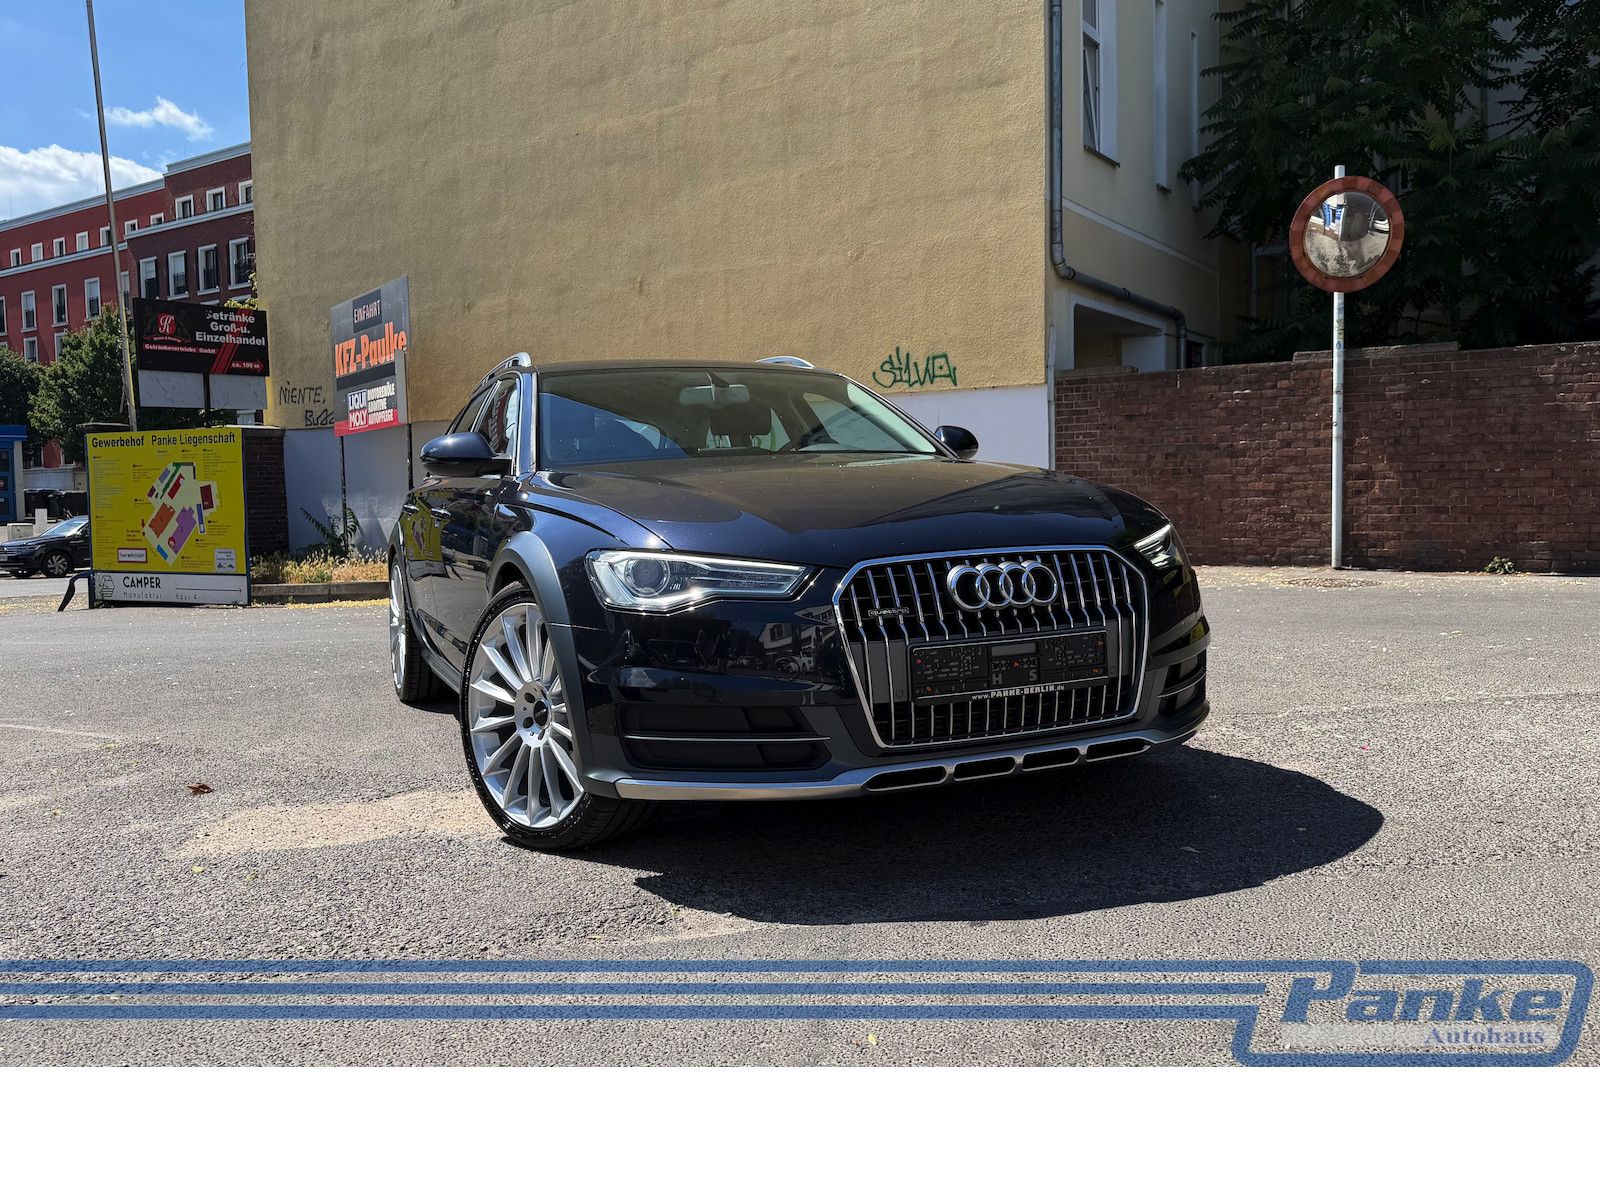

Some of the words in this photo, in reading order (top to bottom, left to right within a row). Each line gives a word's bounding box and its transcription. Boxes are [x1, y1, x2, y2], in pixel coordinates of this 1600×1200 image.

[354, 300, 381, 323] EINFAHRT
[195, 331, 266, 346] Einzelhandel
[335, 321, 407, 378] KFZ-Paulke
[243, 361, 253, 369] 100
[348, 391, 367, 410] LIQUI
[349, 409, 368, 428] MOLY
[91, 435, 145, 448] Gewerbehof
[151, 434, 178, 445] Panke
[179, 431, 236, 447] Liegenschaft
[122, 576, 162, 589] CAMPER
[971, 684, 1065, 700] www.PANKE-BERLIN.de
